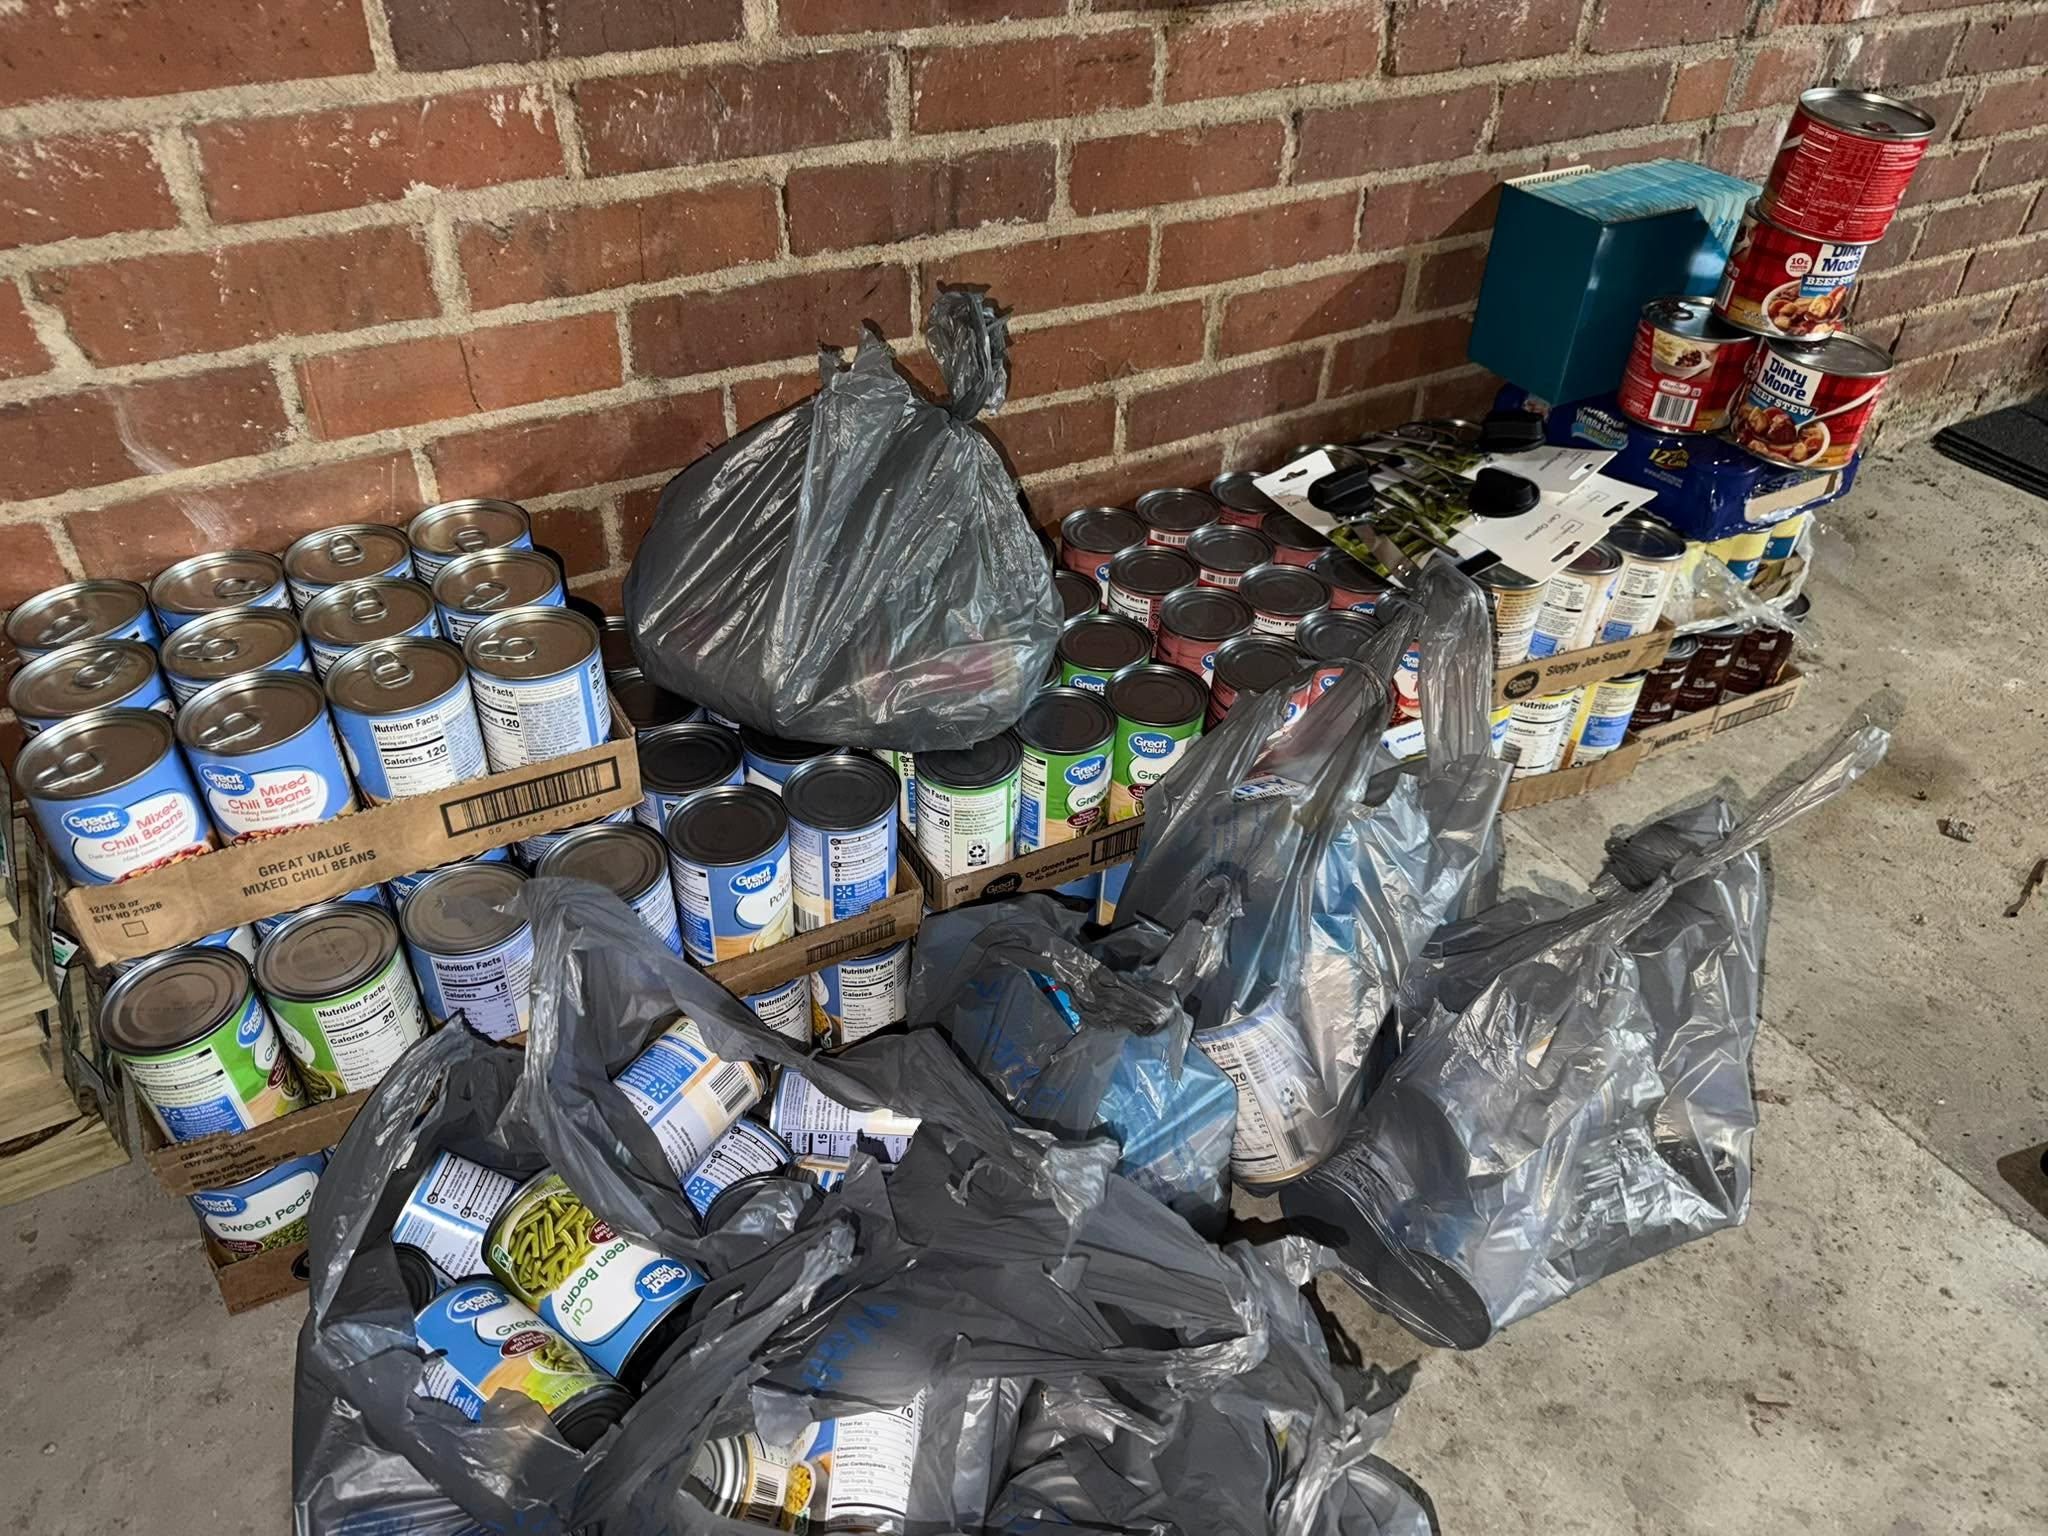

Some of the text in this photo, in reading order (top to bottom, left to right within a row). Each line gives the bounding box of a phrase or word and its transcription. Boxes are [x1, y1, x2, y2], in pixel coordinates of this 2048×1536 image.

[1805, 276, 1839, 286] BEEF
[1769, 357, 1808, 388] Dinty
[1761, 369, 1807, 401] Moore
[1774, 399, 1813, 417] STEW
[1648, 448, 1670, 464] 12
[1545, 649, 1631, 677] Sloppy Joe Sauce
[491, 686, 514, 697] Facts
[1074, 678, 1105, 692] Great
[374, 713, 440, 733] Nutrition Facts
[500, 716, 520, 729] 120
[1508, 725, 1537, 735] Calories
[1134, 736, 1168, 748] Great
[1141, 745, 1167, 754] Value
[384, 744, 448, 766] Calories 120
[1071, 760, 1102, 776] Great
[1137, 770, 1164, 780] Gre
[203, 769, 244, 785] Great
[213, 779, 246, 791] Value
[259, 773, 308, 798] Mixed
[227, 785, 311, 811] Chili Beans
[930, 788, 950, 802] Facts
[1075, 786, 1107, 808] Green
[68, 811, 118, 829] Great
[136, 797, 179, 830] Mixed
[510, 814, 546, 829] 78742
[554, 802, 588, 817] 21326
[82, 820, 121, 834] Value
[101, 834, 139, 852] Chili
[142, 809, 184, 840] Beans
[938, 818, 950, 828] 20
[257, 842, 352, 879] GREAT VALUE
[1041, 861, 1066, 874] Green
[1065, 853, 1090, 866] Beans
[1058, 863, 1080, 874] Added
[243, 850, 377, 898] MIXED CHILI BEANS
[735, 865, 771, 887] Great
[745, 875, 772, 890] Value
[986, 878, 1016, 894] Great
[92, 913, 114, 924] STK
[132, 901, 163, 917] 21326
[436, 956, 502, 972] Nutrition Facts
[841, 960, 894, 975] Nutrition Facts
[443, 981, 508, 999] Calories 15
[883, 981, 894, 991] 70
[317, 984, 386, 1018] Nutrition Facts
[758, 992, 790, 1008] Nutrition
[330, 1009, 395, 1046] Calories 20
[1212, 1041, 1235, 1054] Facts
[1232, 1072, 1247, 1083] 70
[818, 1133, 828, 1145] 15
[193, 1195, 236, 1210] Great
[219, 1189, 312, 1232] Sweet Peas
[596, 1239, 631, 1268] reen
[640, 1264, 673, 1285] Value
[647, 1265, 687, 1294] Great
[561, 1268, 599, 1314] Beans
[453, 1291, 498, 1313] Great
[571, 1297, 594, 1327] Cut
[495, 1320, 546, 1336] Green
[850, 1461, 886, 1469] Carbohydrate
